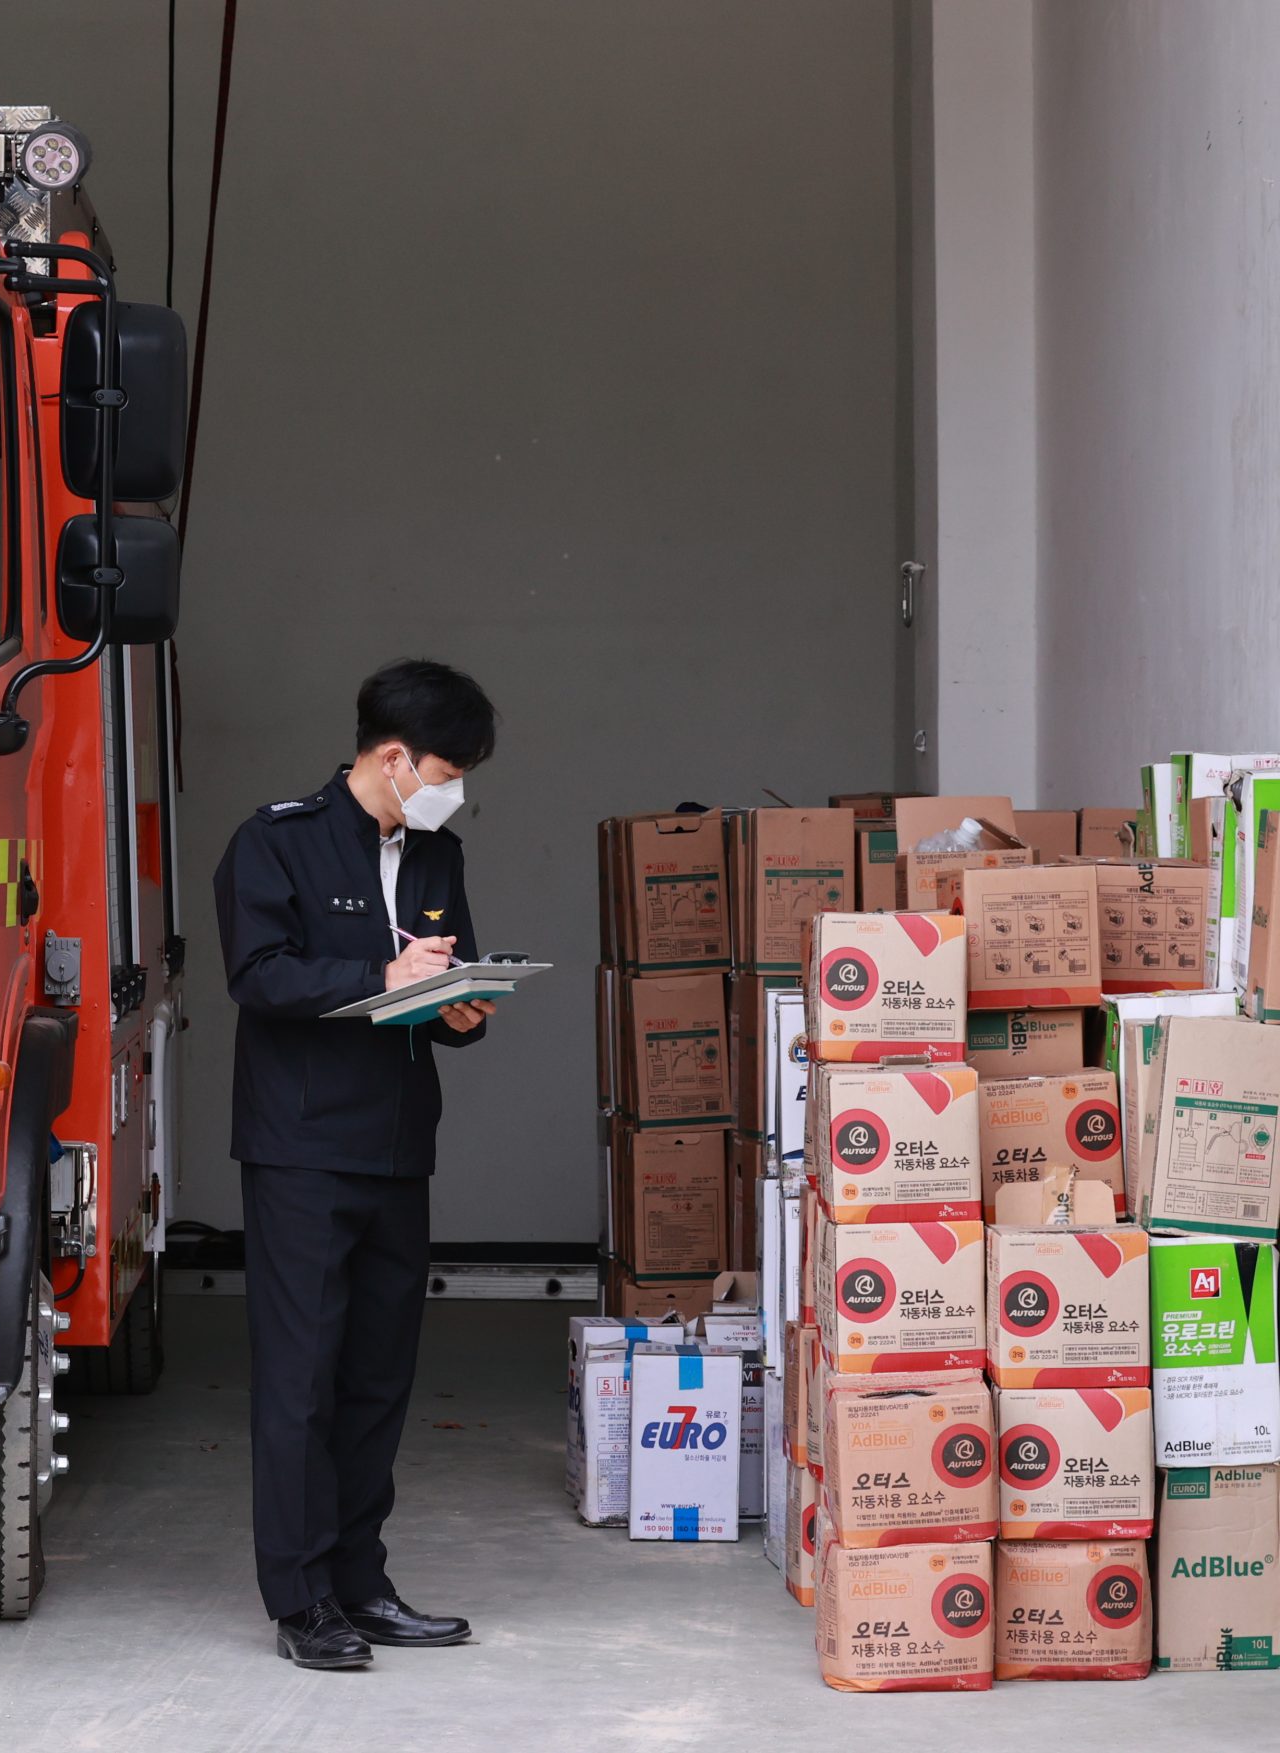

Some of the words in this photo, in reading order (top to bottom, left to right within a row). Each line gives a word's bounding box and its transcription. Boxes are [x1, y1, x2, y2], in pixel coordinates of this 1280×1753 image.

[882, 981, 925, 996] 오터스
[882, 998, 922, 1010] 자동차용
[926, 998, 955, 1010] 요소수
[974, 1036, 995, 1044] EURO
[1081, 1134, 1113, 1142] AUTOUS
[894, 1141, 939, 1157] 오터스
[894, 1158, 935, 1170] 자동차용
[939, 1157, 970, 1169] 요소수
[992, 1147, 1047, 1166] 오터스
[993, 1168, 1039, 1183] 자동차용
[1194, 1273, 1215, 1292] A1
[900, 1290, 944, 1305] 오터스
[900, 1307, 941, 1319] 자동차용
[945, 1305, 975, 1317] 요소수
[1009, 1309, 1045, 1317] AUTOUS
[1063, 1304, 1108, 1320] 오터스
[1063, 1321, 1104, 1334] 자동차용
[1108, 1320, 1139, 1332] 요소수
[1162, 1320, 1235, 1342] 유로크린
[1163, 1342, 1206, 1356] 요소수
[705, 1411, 721, 1419] 유로
[723, 1411, 728, 1419] 7
[641, 1422, 727, 1450] EURO
[1254, 1425, 1270, 1435] 10L
[947, 1460, 982, 1469] AUTOUS
[1064, 1458, 1109, 1473] 오터스
[852, 1472, 910, 1490] 오터스
[1064, 1475, 1105, 1488] 자동차용
[1109, 1474, 1141, 1487] 요소수
[1214, 1471, 1262, 1481] Adblue
[852, 1495, 902, 1509] 자동차용
[907, 1491, 946, 1506] 요소수
[947, 1610, 981, 1618] AUTOUS
[1007, 1608, 1064, 1625] 오터스
[852, 1621, 911, 1638] 오터스
[1006, 1630, 1054, 1644] 자동차용
[1060, 1630, 1098, 1644] 요소수
[852, 1643, 901, 1657] 자동차용
[907, 1641, 945, 1654] 요소수
[1252, 1640, 1268, 1649] 10L
